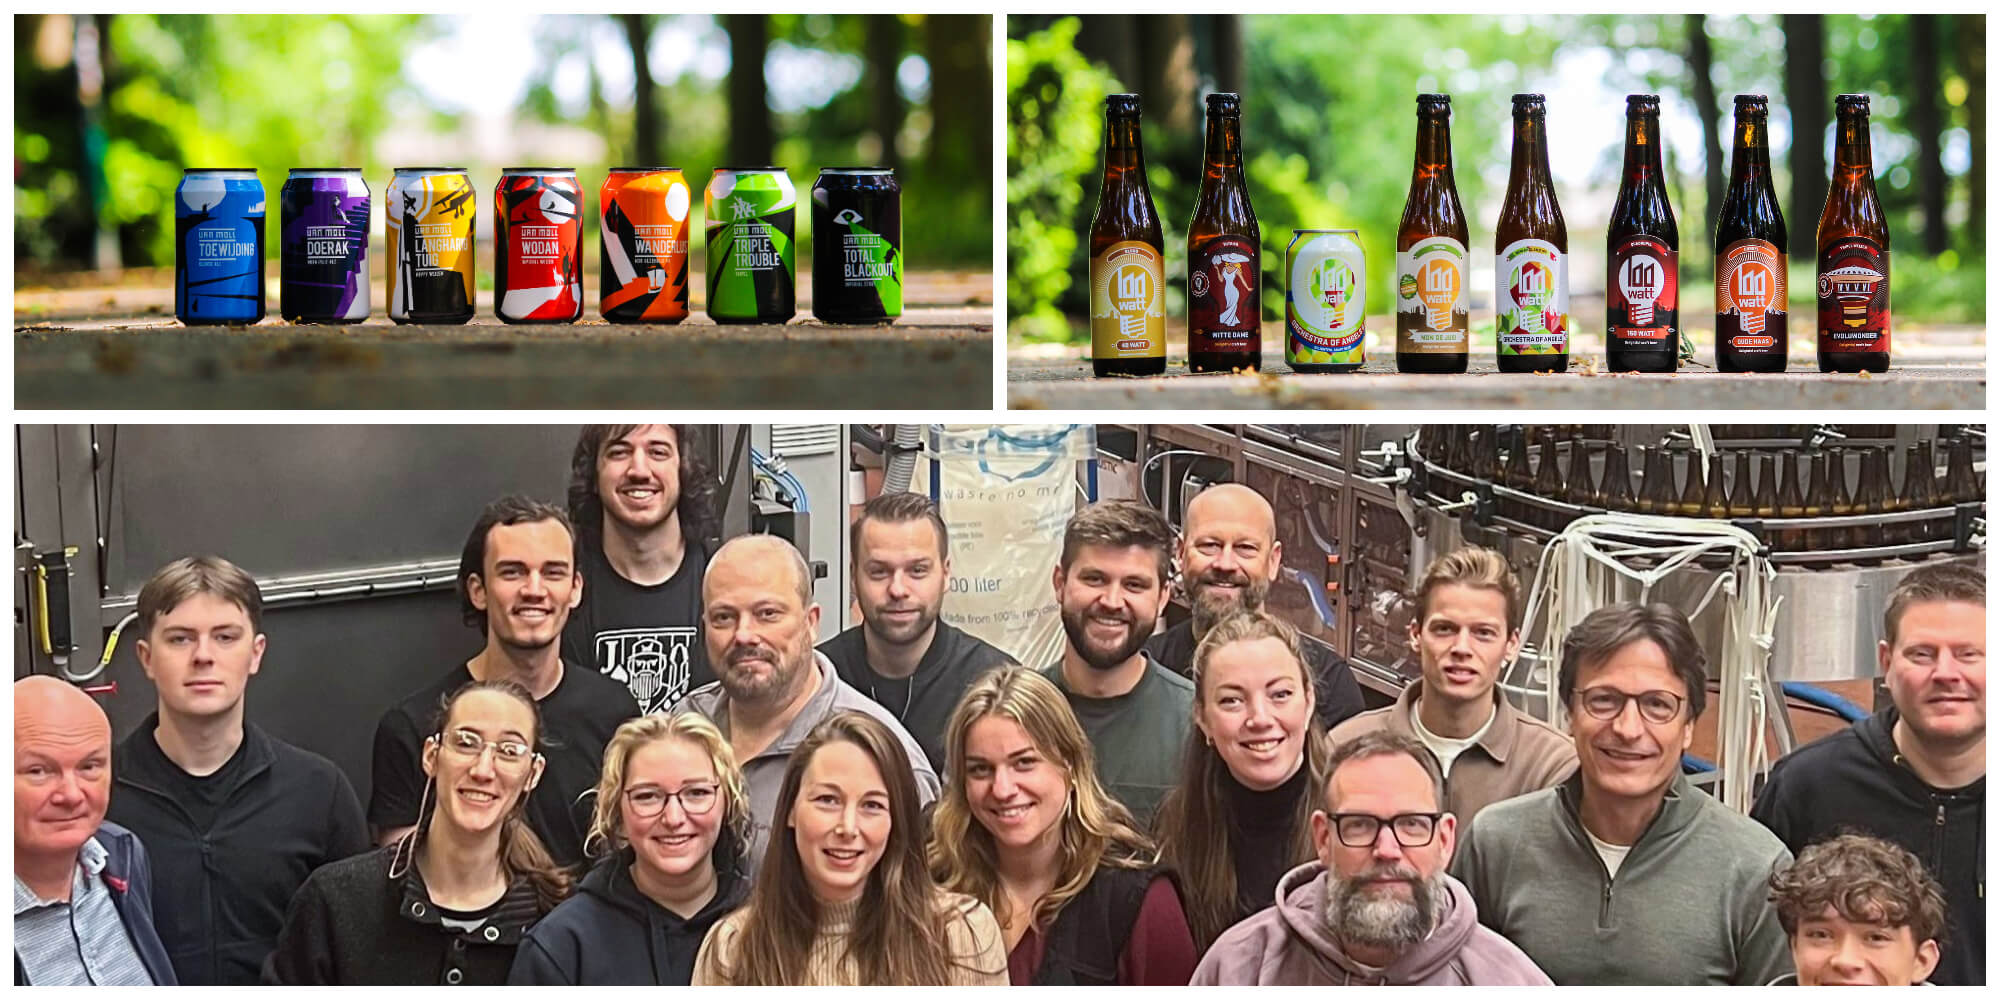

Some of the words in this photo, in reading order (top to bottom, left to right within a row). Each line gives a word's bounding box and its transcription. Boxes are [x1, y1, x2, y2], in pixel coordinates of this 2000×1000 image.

[199, 242, 255, 257] TOEWIJDING
[307, 240, 350, 255] DOERAK
[521, 240, 559, 255] WODAN
[635, 239, 688, 254] WANDERLUS
[735, 238, 771, 253] TRIPLE
[415, 253, 439, 268] TUIG
[735, 252, 781, 267] TROUBLE
[844, 249, 876, 264] TOTAL
[844, 262, 894, 278] BLACKOUT
[1425, 291, 1453, 304] watt
[1627, 287, 1655, 300] watt
[1119, 297, 1147, 312] watt
[1738, 295, 1766, 308] watt
[1291, 319, 1328, 346] ORCHESTRA
[1330, 338, 1340, 346] OF
[1341, 327, 1363, 346] ANGELS
[1637, 329, 1656, 337] WATT
[1005, 487, 1026, 502] no
[949, 576, 969, 593] 00
[974, 576, 1002, 593] liter
[967, 613, 991, 625] from
